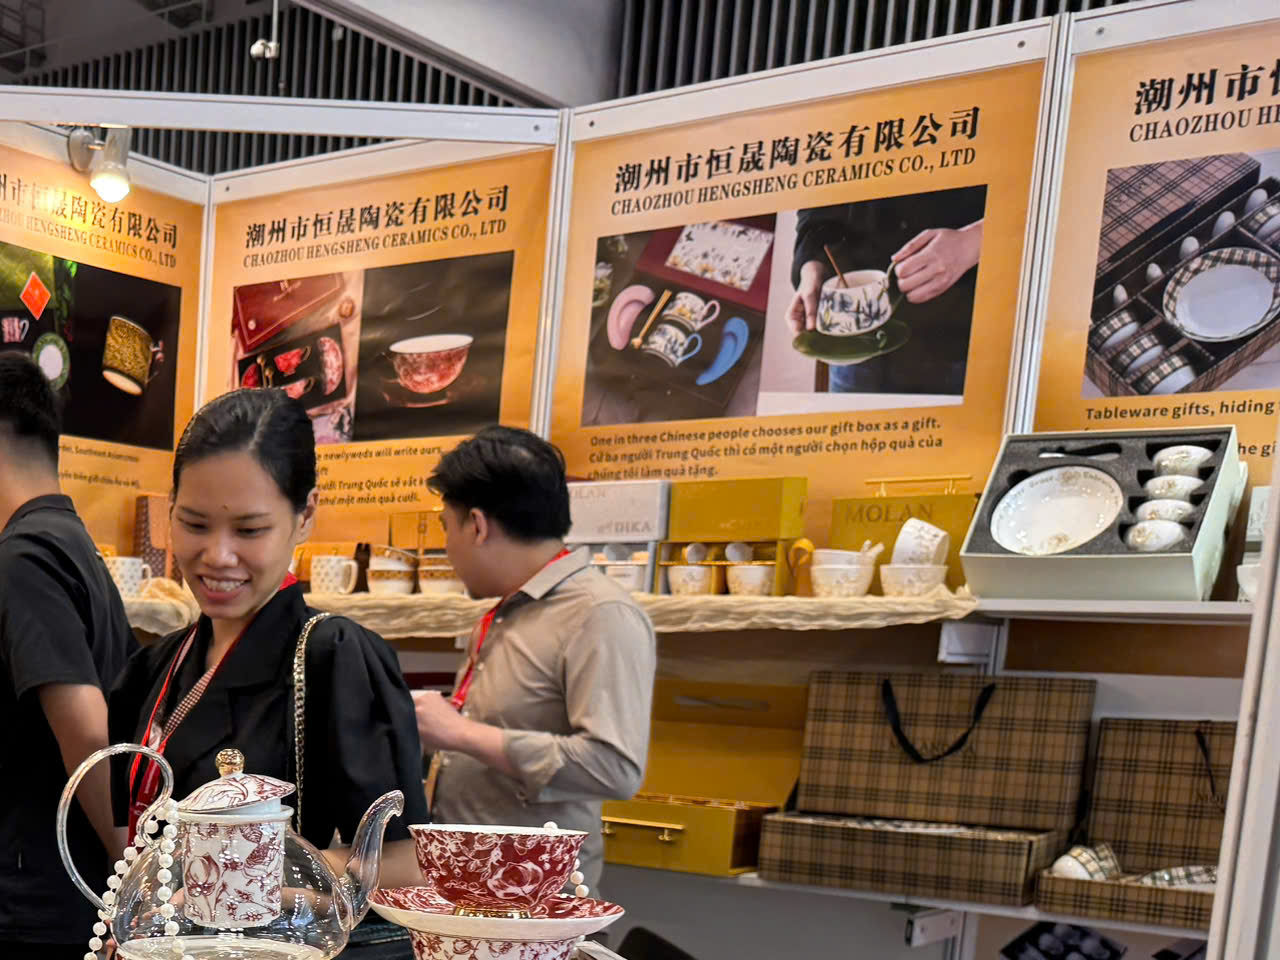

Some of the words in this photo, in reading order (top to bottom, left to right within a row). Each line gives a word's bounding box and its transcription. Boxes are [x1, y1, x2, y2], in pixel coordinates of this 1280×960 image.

[614, 106, 980, 193] 潮州市恒晟陶瓷有限公司
[1129, 108, 1253, 142] CHAOZHOU
[611, 188, 694, 215] CHAOZHOU
[697, 173, 797, 203] HENGSHENG
[802, 158, 894, 187] CERAMICS
[898, 154, 933, 173] CO.,
[938, 147, 975, 168] LTD
[245, 184, 510, 249] 潮州市恒晟陶瓷有限公司
[26, 217, 88, 246] HENGSHENG
[89, 231, 138, 259] CERAMICS
[158, 251, 177, 269] LTD
[243, 245, 305, 267] CHAOZHOU
[306, 236, 380, 259] HENGSHENG
[382, 225, 448, 248] CERAMICS
[480, 218, 506, 235] LTD
[614, 434, 625, 445] in
[626, 433, 657, 444] three
[659, 430, 705, 442] Chinese
[707, 427, 749, 442] people
[751, 425, 802, 437] chooses
[805, 425, 828, 435] our
[829, 421, 853, 437] gift
[856, 420, 880, 432] box
[883, 421, 898, 430] as
[911, 416, 940, 432] gift.
[1086, 405, 1168, 420] Tableware
[1171, 402, 1214, 419] gifts,
[1219, 399, 1275, 415] hiding
[845, 502, 935, 524] MOLAN
